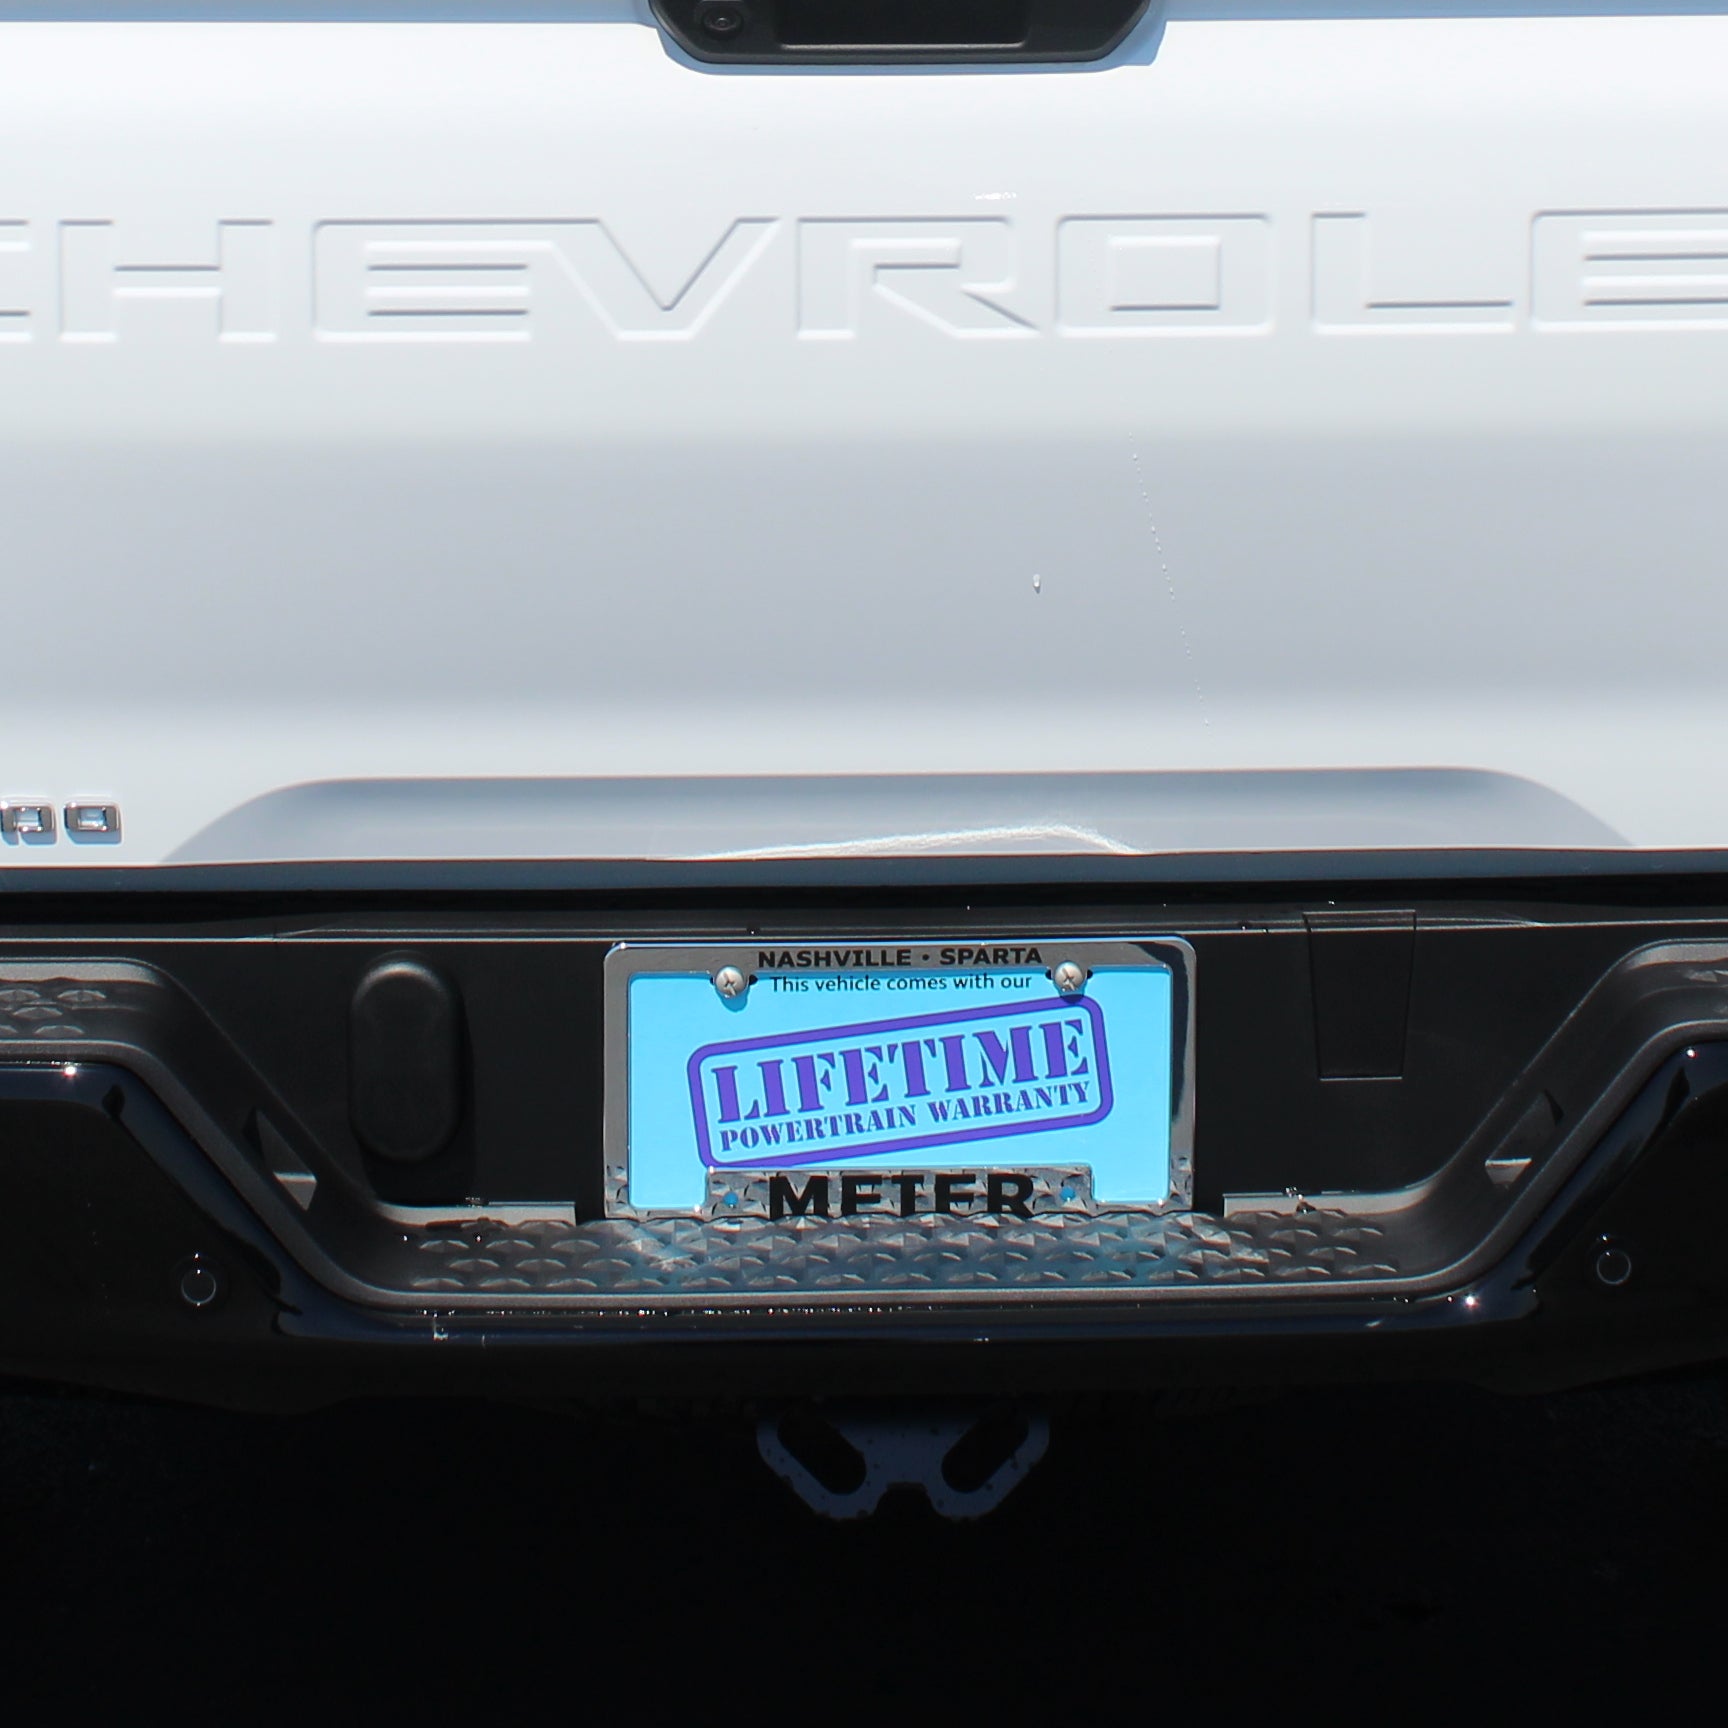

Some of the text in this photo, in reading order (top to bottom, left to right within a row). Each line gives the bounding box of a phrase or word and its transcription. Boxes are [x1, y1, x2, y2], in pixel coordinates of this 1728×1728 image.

[757, 947, 1043, 968] NASHVILLE SPARTA
[770, 972, 1032, 993] This vehicle comes with our
[711, 1019, 1088, 1123] LIFETIME
[720, 1081, 1090, 1153] POWERTRAIN WARRANTY
[769, 1174, 1035, 1219] METER
